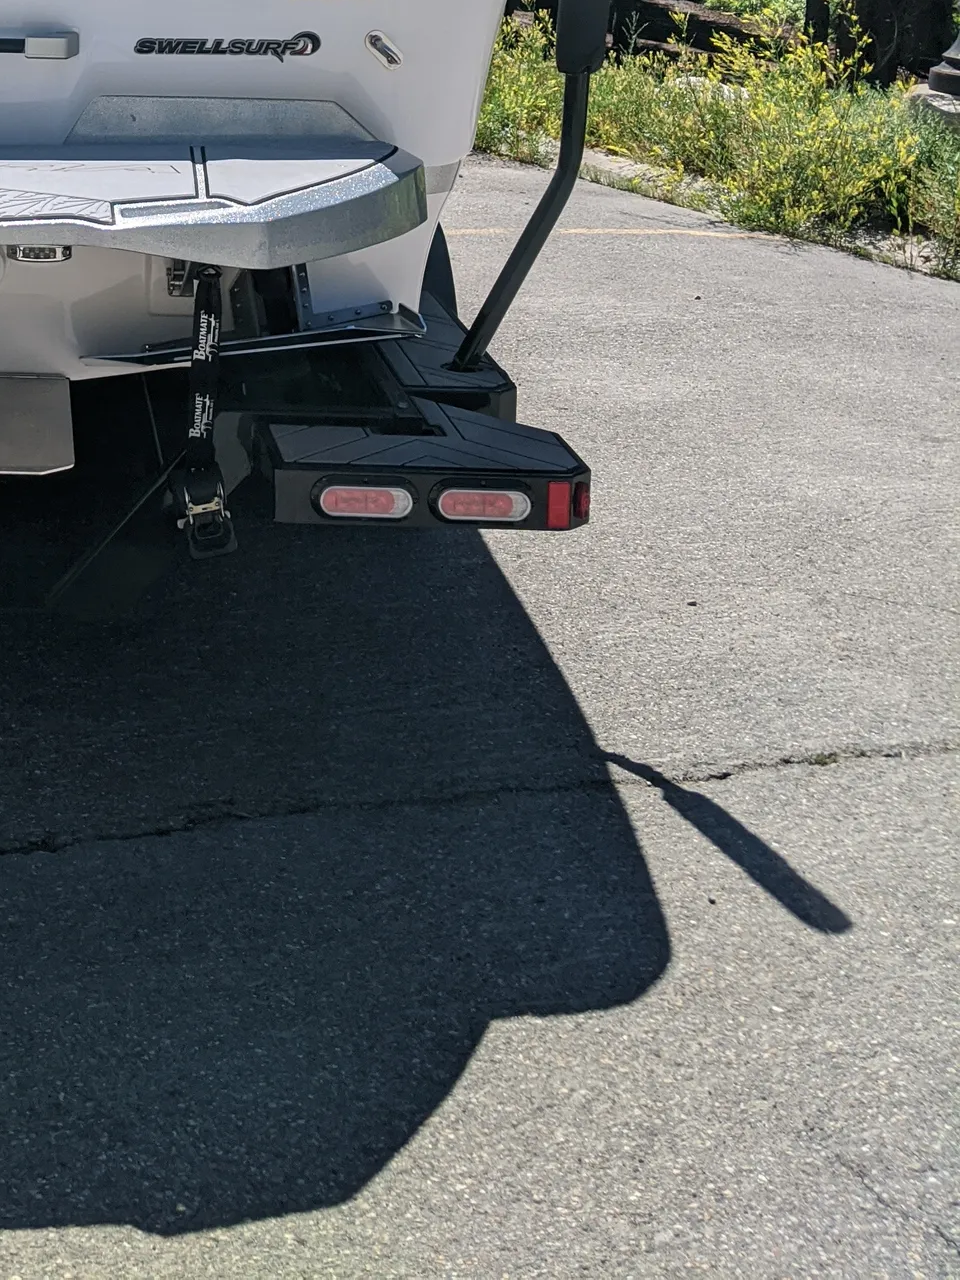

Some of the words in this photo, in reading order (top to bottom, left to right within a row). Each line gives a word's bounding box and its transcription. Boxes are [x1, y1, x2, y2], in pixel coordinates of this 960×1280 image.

[134, 37, 302, 63] SWELLSURF
[193, 312, 209, 361] BOATMATE
[189, 394, 204, 438] BOATMATE
